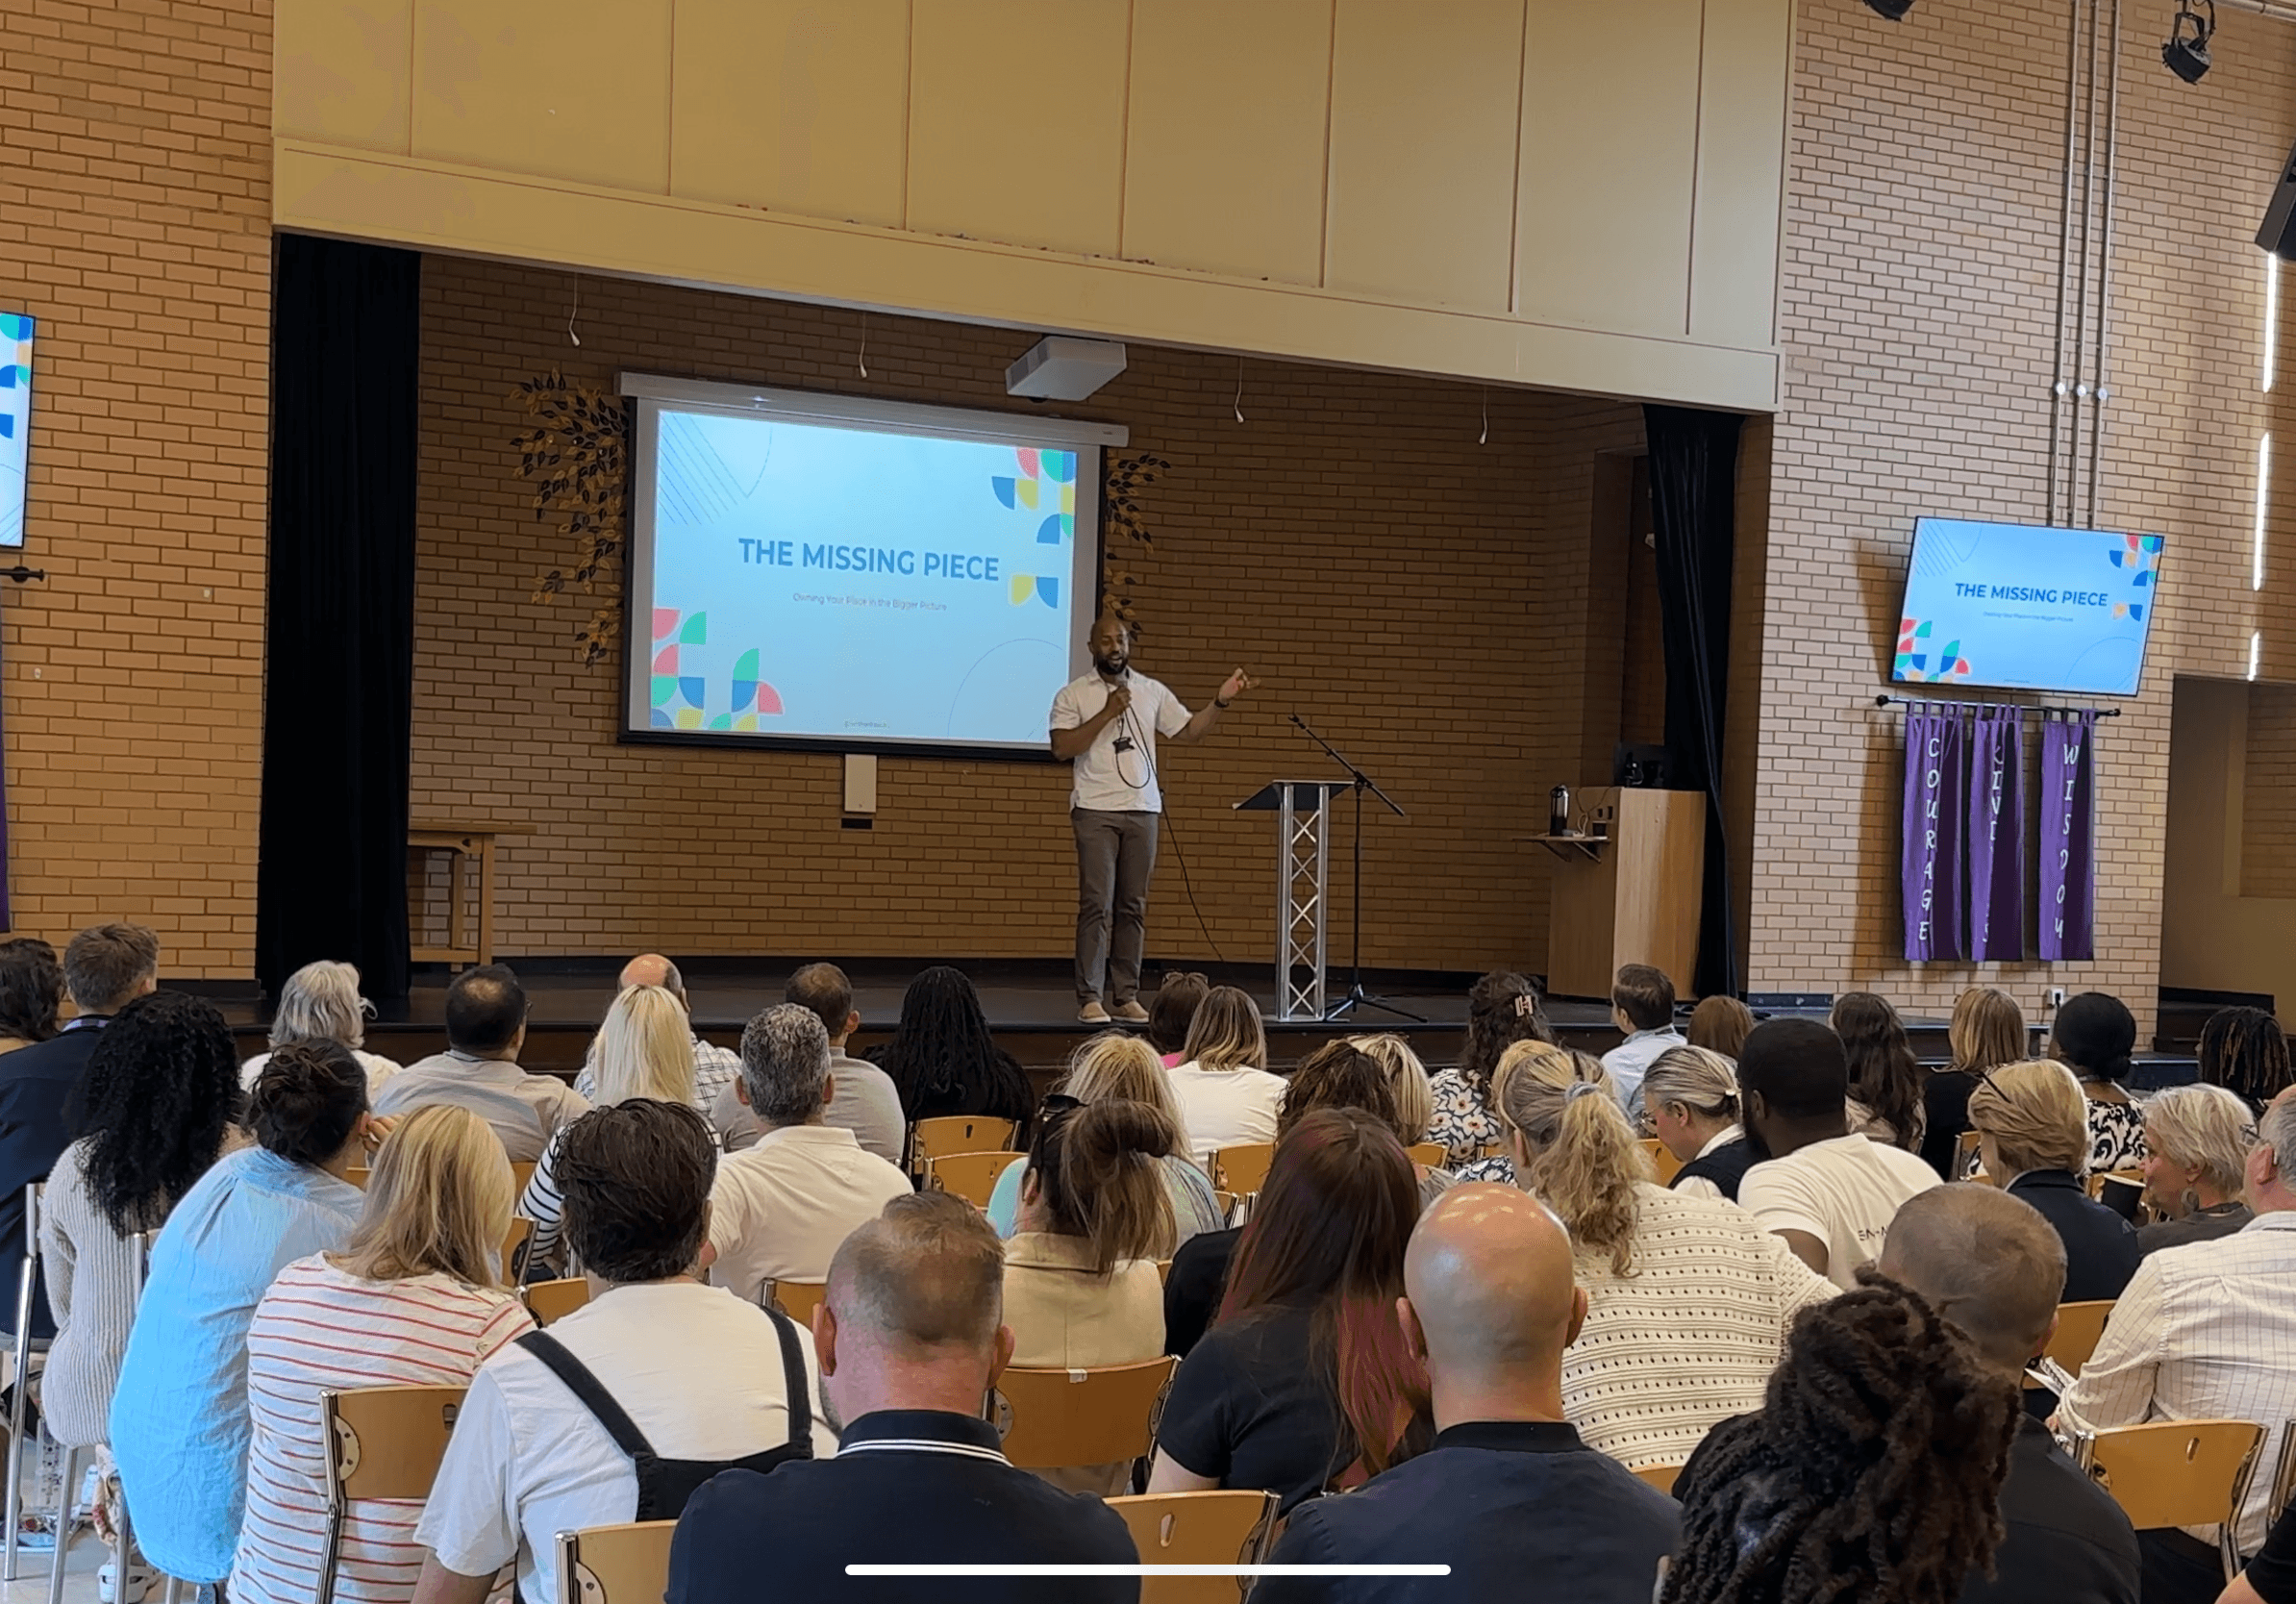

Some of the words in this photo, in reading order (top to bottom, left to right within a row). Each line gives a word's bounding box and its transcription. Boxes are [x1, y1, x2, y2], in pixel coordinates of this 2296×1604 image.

[738, 538, 793, 566] THE
[802, 542, 914, 575] MISSING
[923, 552, 1000, 581] PIECE
[792, 592, 825, 605] Owning
[826, 594, 844, 604] Your
[878, 598, 891, 608] the
[892, 599, 918, 611] Bigger
[919, 601, 947, 612] Picture
[1956, 583, 1987, 598] THE
[1990, 585, 2058, 603] MISSING
[2061, 590, 2109, 607] PIECE
[1918, 738, 1940, 940] COURAGE
